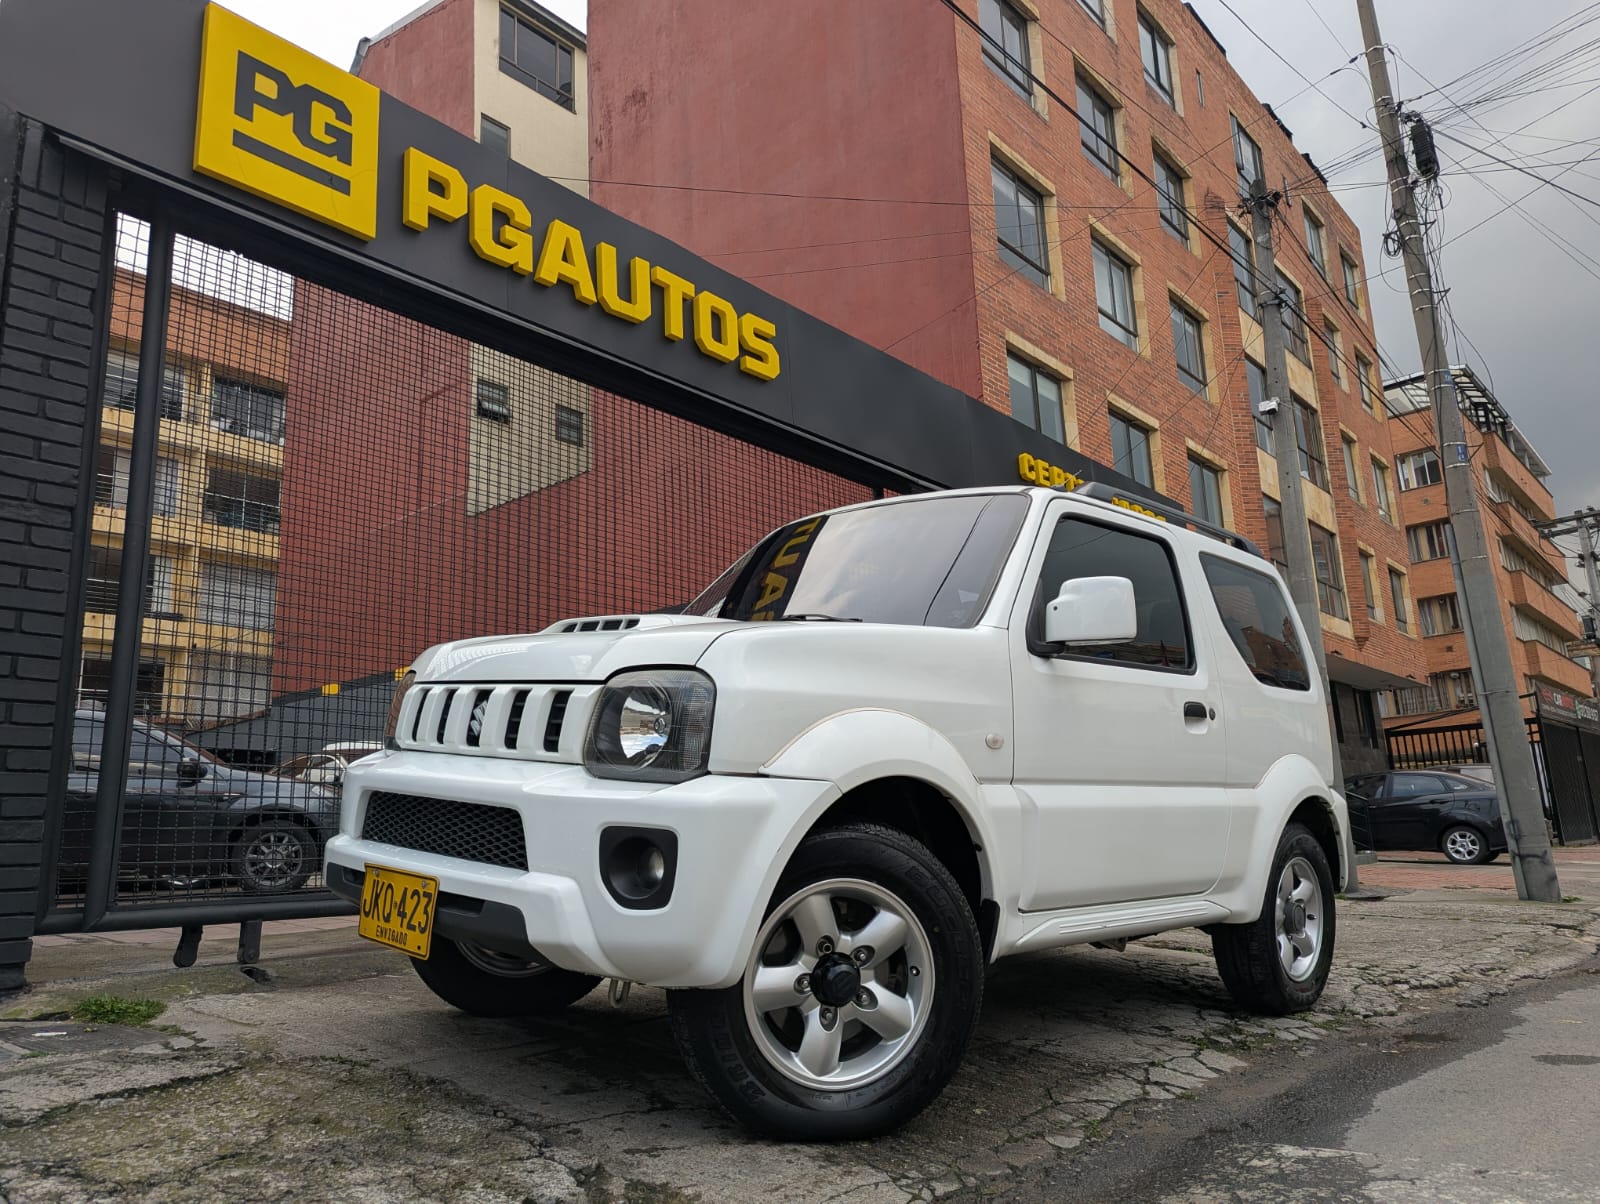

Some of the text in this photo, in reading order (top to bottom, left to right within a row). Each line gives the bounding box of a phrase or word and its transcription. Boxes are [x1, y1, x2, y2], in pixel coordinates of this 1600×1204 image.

[234, 49, 353, 167] PG
[402, 146, 781, 382] PGAUTOS
[375, 924, 408, 946] ENVIGADO
